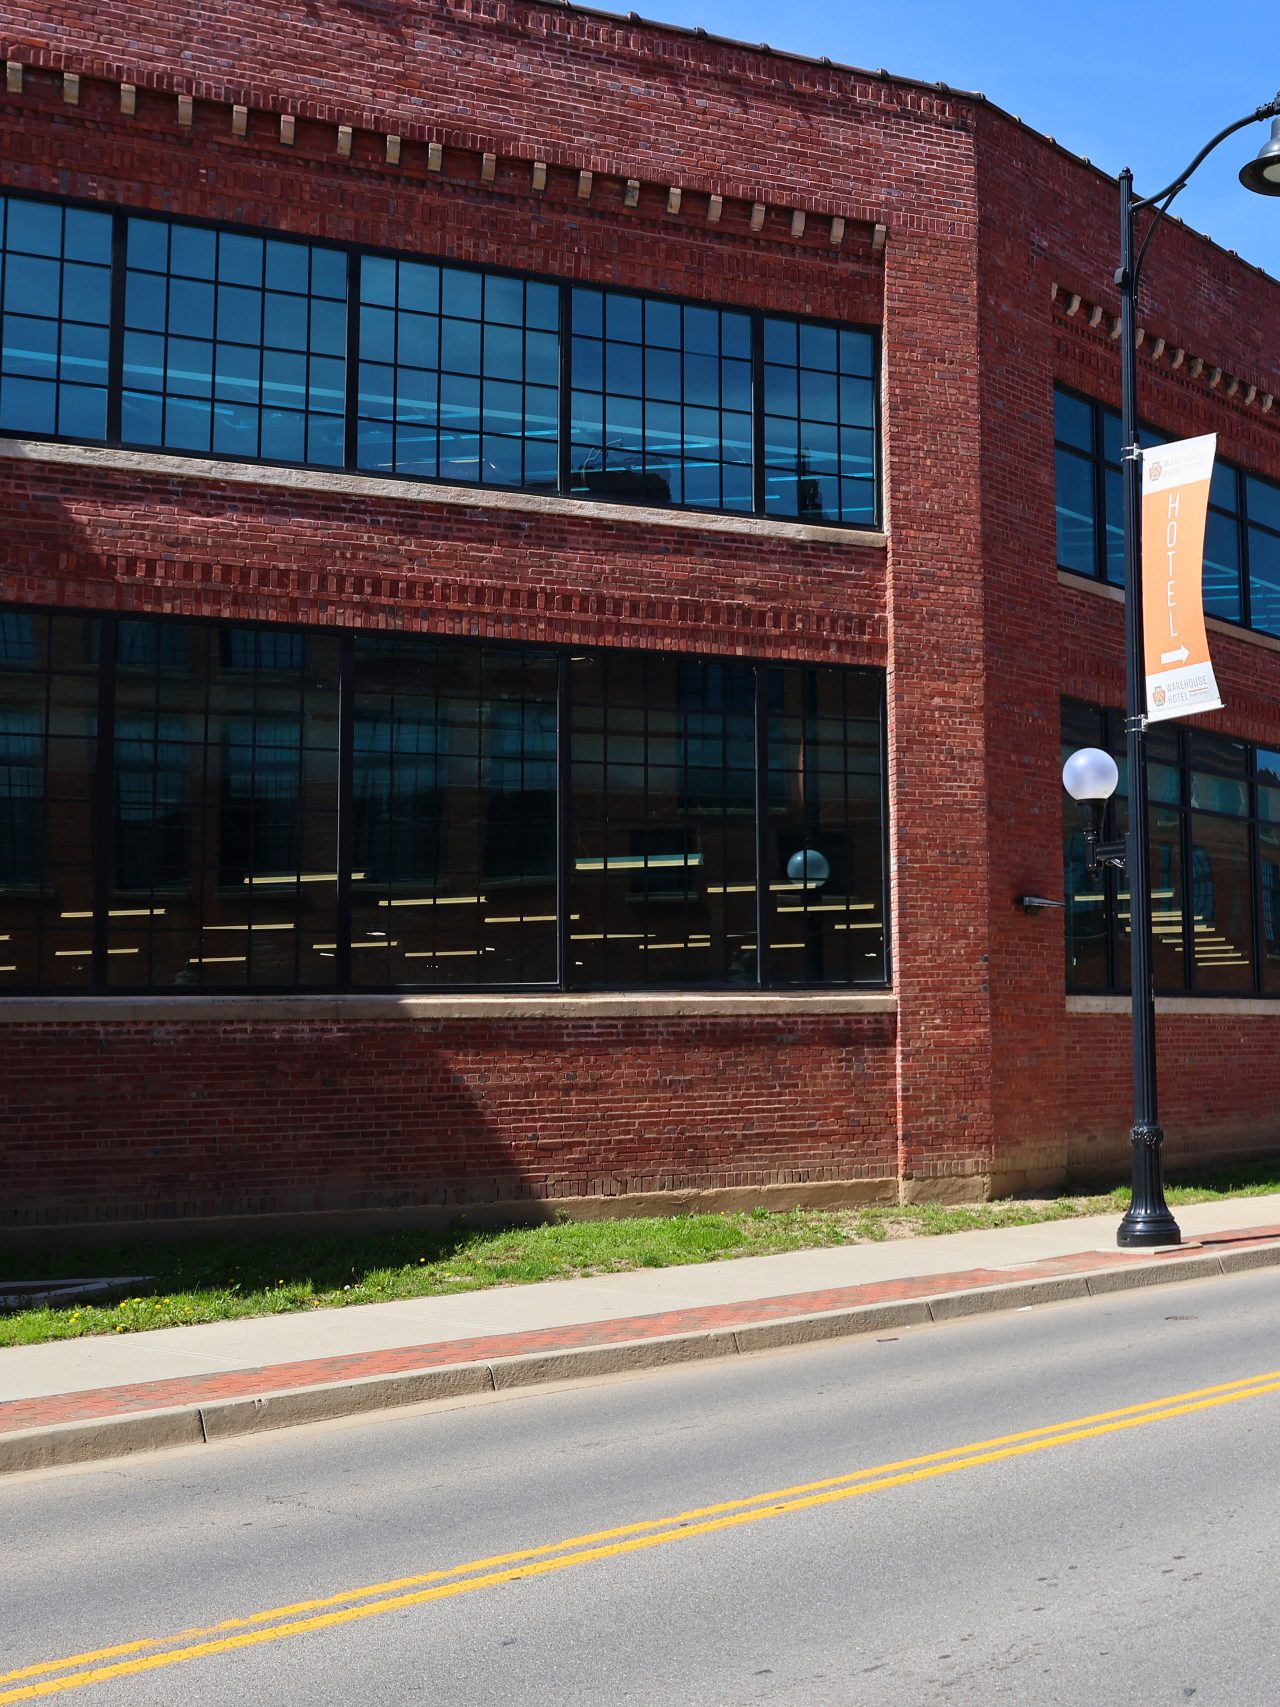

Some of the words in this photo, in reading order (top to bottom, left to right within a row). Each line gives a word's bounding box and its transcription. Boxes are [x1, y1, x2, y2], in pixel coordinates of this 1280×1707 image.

[1166, 492, 1179, 638] HOTEL
[1167, 676, 1208, 692] WAREHOUSE
[1167, 692, 1189, 704] HOTEL
